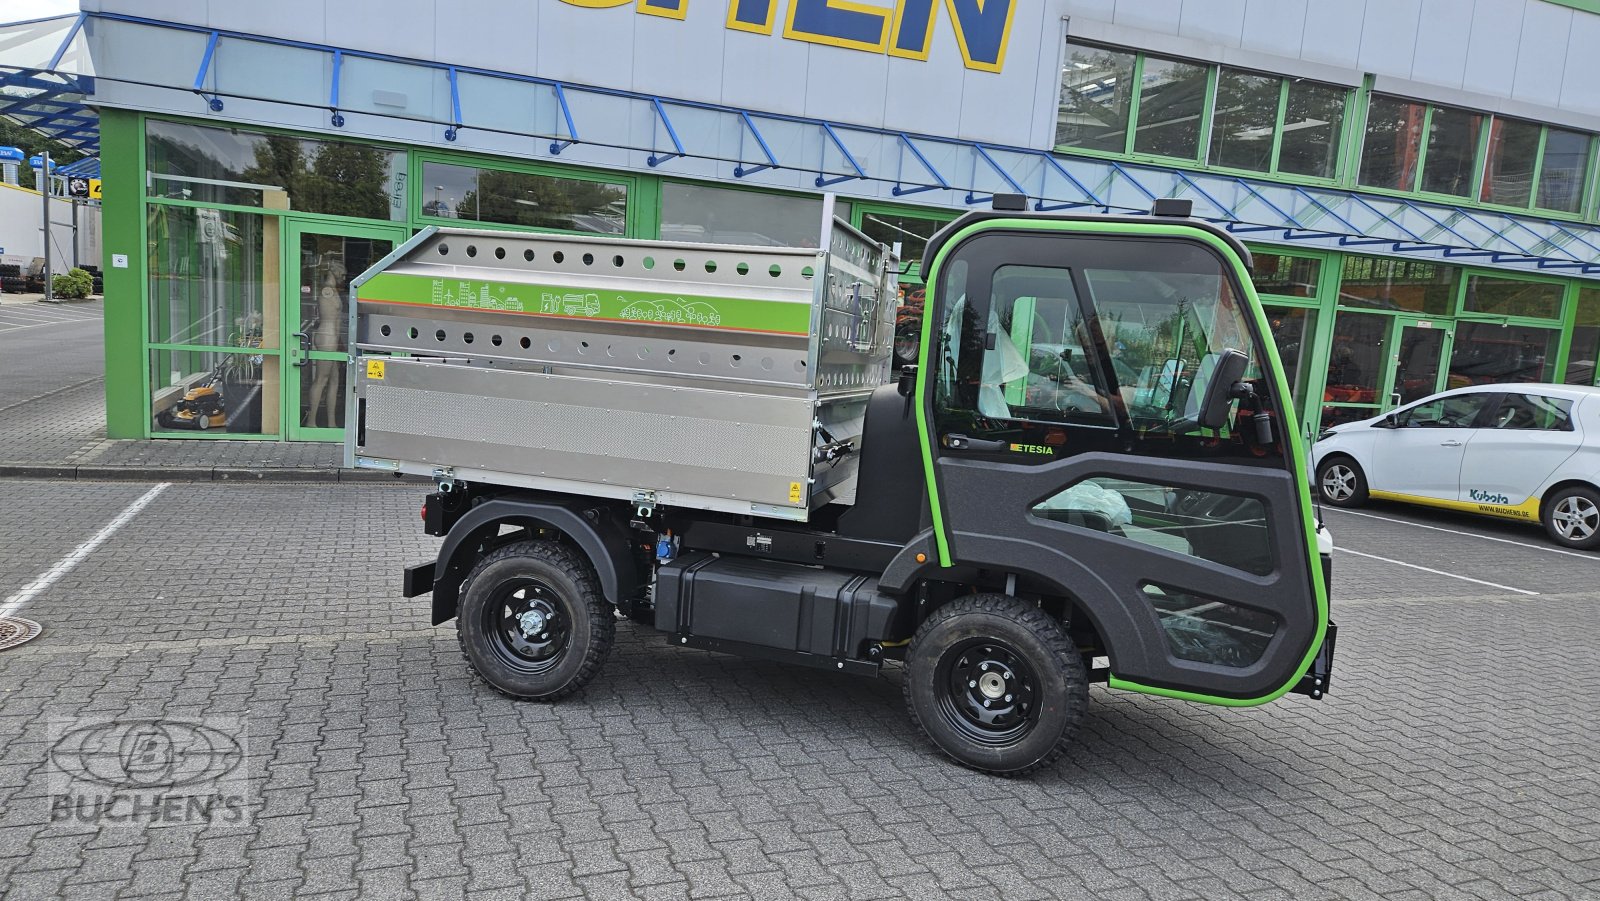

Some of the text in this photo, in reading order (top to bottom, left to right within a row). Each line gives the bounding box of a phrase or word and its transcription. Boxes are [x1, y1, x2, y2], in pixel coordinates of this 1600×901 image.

[1010, 443, 1053, 454] ETESIA
[1469, 489, 1508, 504] Kubota
[1479, 505, 1530, 517] WWW.BUCHENS.DE
